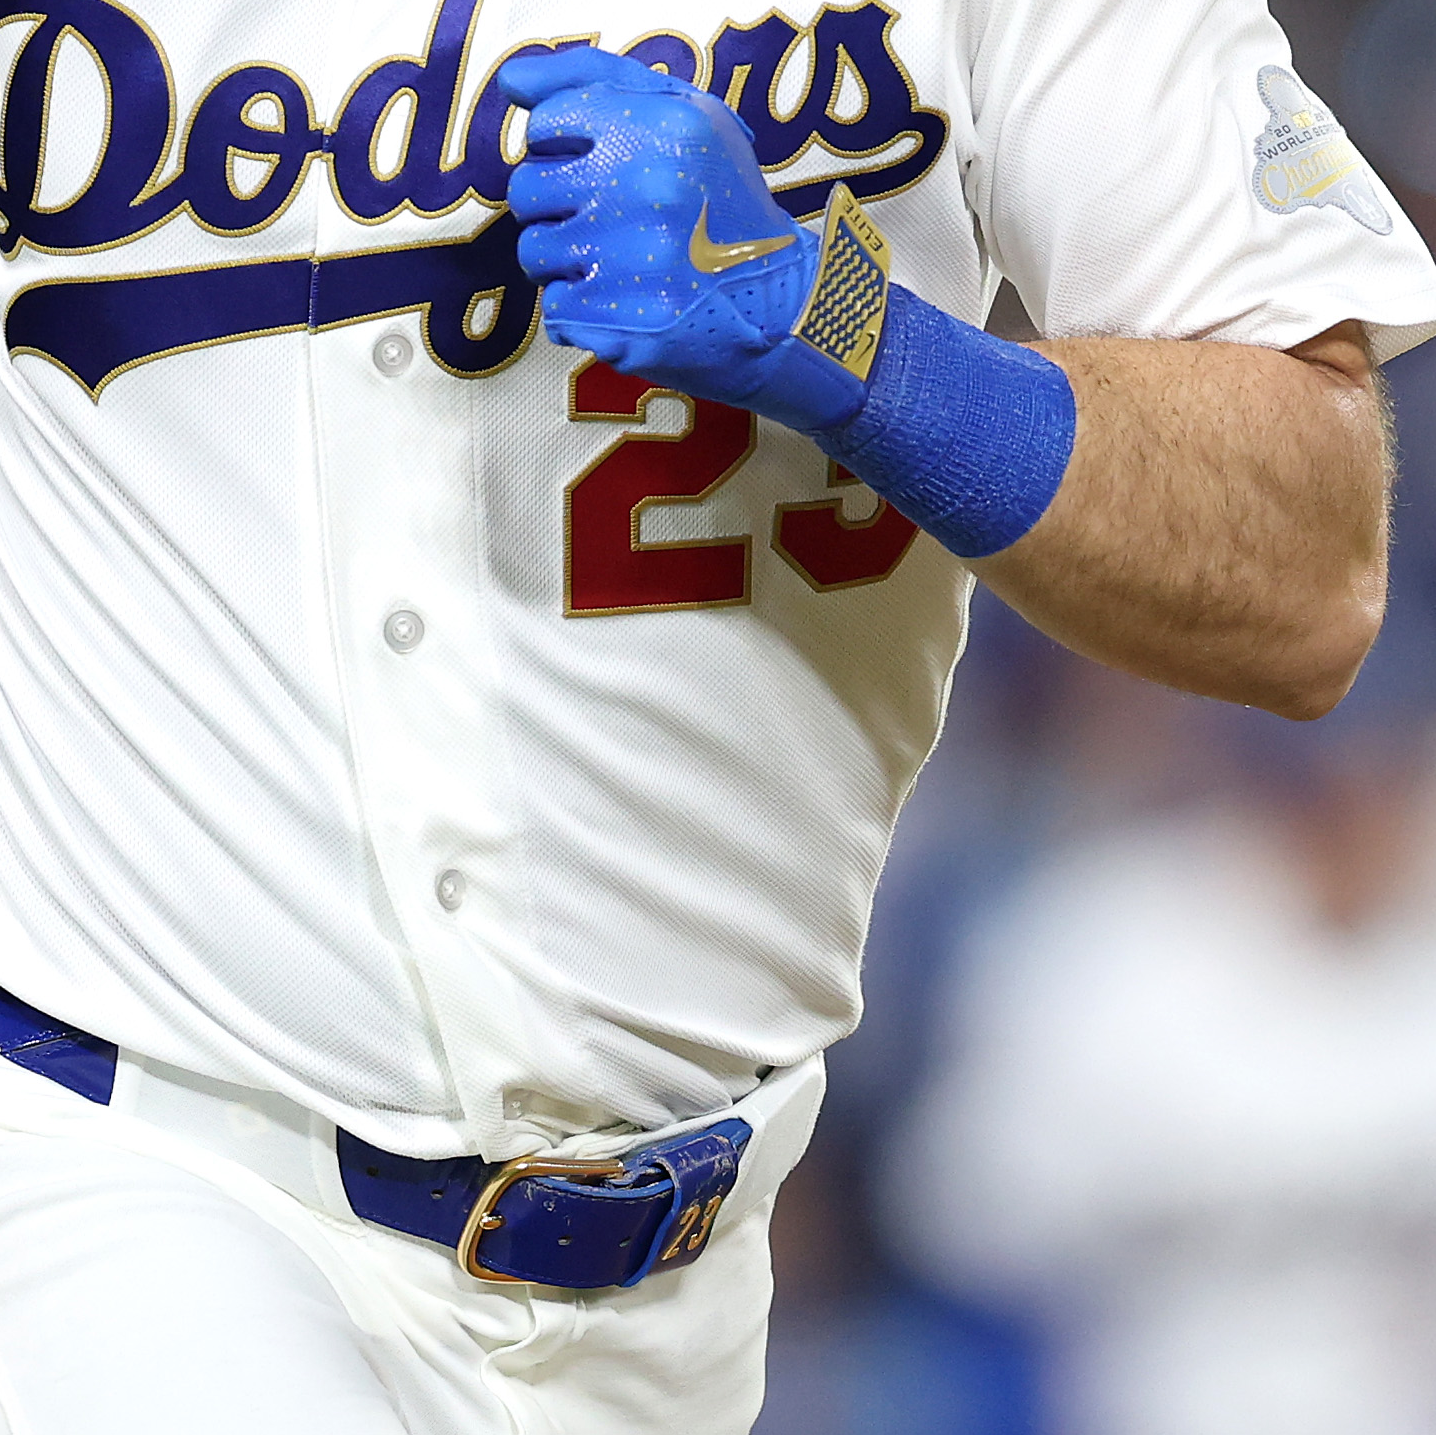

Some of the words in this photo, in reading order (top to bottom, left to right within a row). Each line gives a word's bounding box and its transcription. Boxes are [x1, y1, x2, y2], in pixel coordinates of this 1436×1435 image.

[1262, 130, 1314, 159] WORLD
[843, 197, 884, 253] ELITE
[661, 1194, 723, 1261] 23
